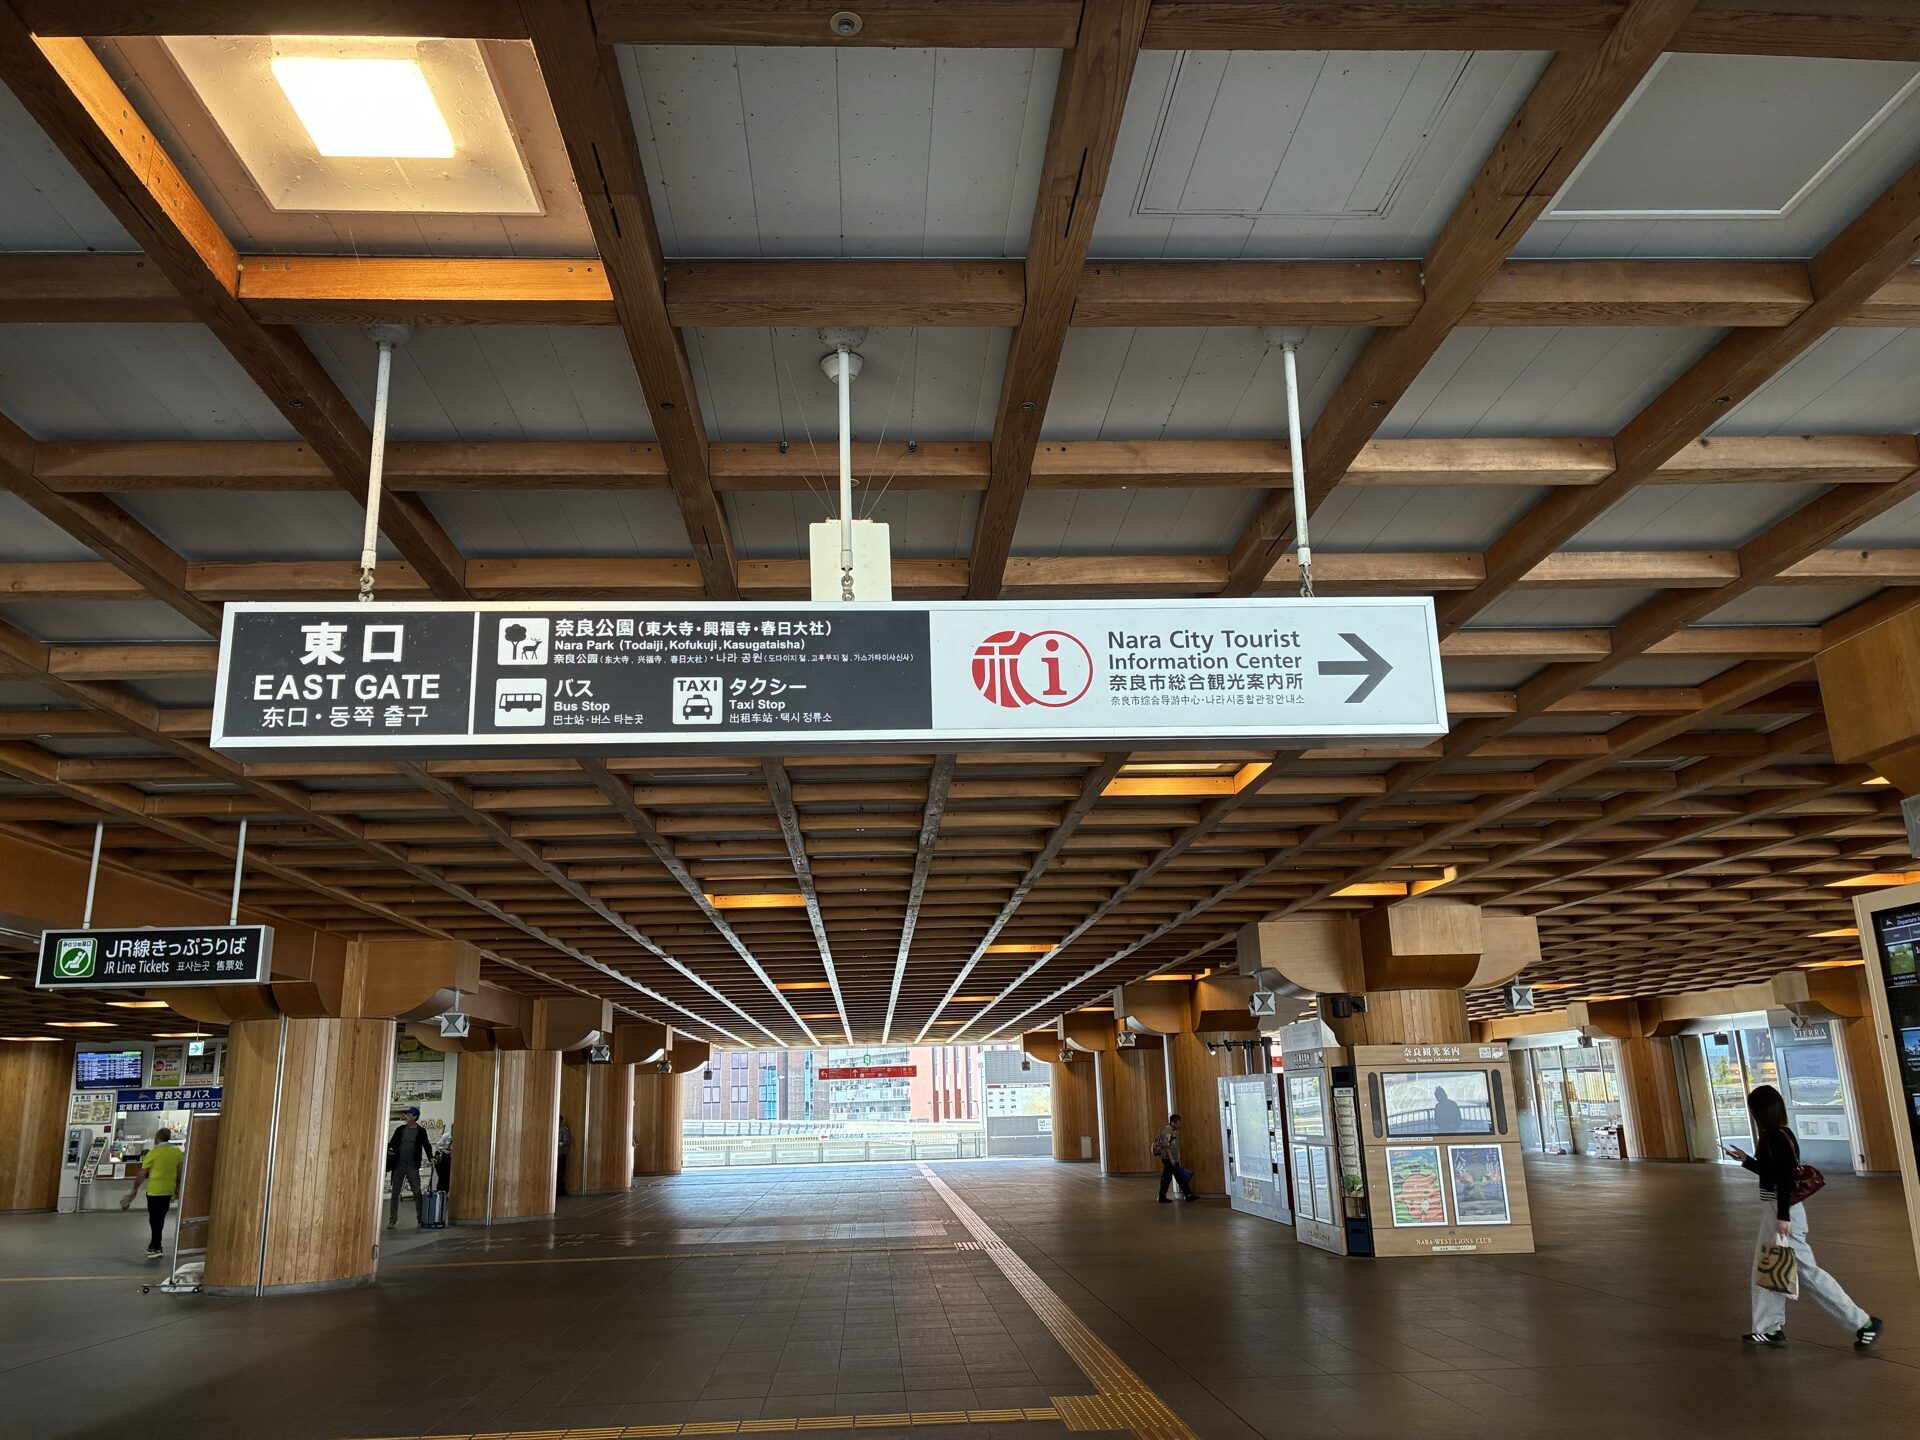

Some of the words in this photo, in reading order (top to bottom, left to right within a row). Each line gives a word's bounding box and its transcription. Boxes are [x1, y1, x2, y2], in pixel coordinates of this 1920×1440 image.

[299, 622, 406, 666] 東口
[554, 640, 584, 651] Nara
[586, 640, 614, 650] Park
[1107, 630, 1162, 649] Nara
[1169, 629, 1214, 653] City
[1221, 628, 1301, 648] Tourist
[1109, 652, 1229, 670] Information
[1235, 652, 1302, 669] Center
[253, 673, 346, 702] EAST
[354, 673, 440, 702] GATE
[554, 678, 594, 698] バス
[677, 679, 718, 692] TAXI
[729, 677, 807, 696] タクシー
[1109, 673, 1304, 692] 奈良市総合観光案内所
[554, 701, 578, 711] Bus
[582, 700, 611, 713] Stop
[729, 699, 754, 710] Taxi
[758, 699, 786, 711] Stop
[383, 704, 430, 727] 출구
[614, 714, 644, 725] 타는곳
[803, 712, 833, 723] 정류소
[106, 936, 247, 959] JR線きっぷうりば
[104, 960, 115, 975] JR
[117, 960, 137, 974] Line
[139, 958, 170, 973] Tickets
[1404, 1046, 1461, 1057] 奈良観光案内
[154, 1090, 210, 1100] 奈良交通バス
[119, 1102, 160, 1111] 定期観光バス
